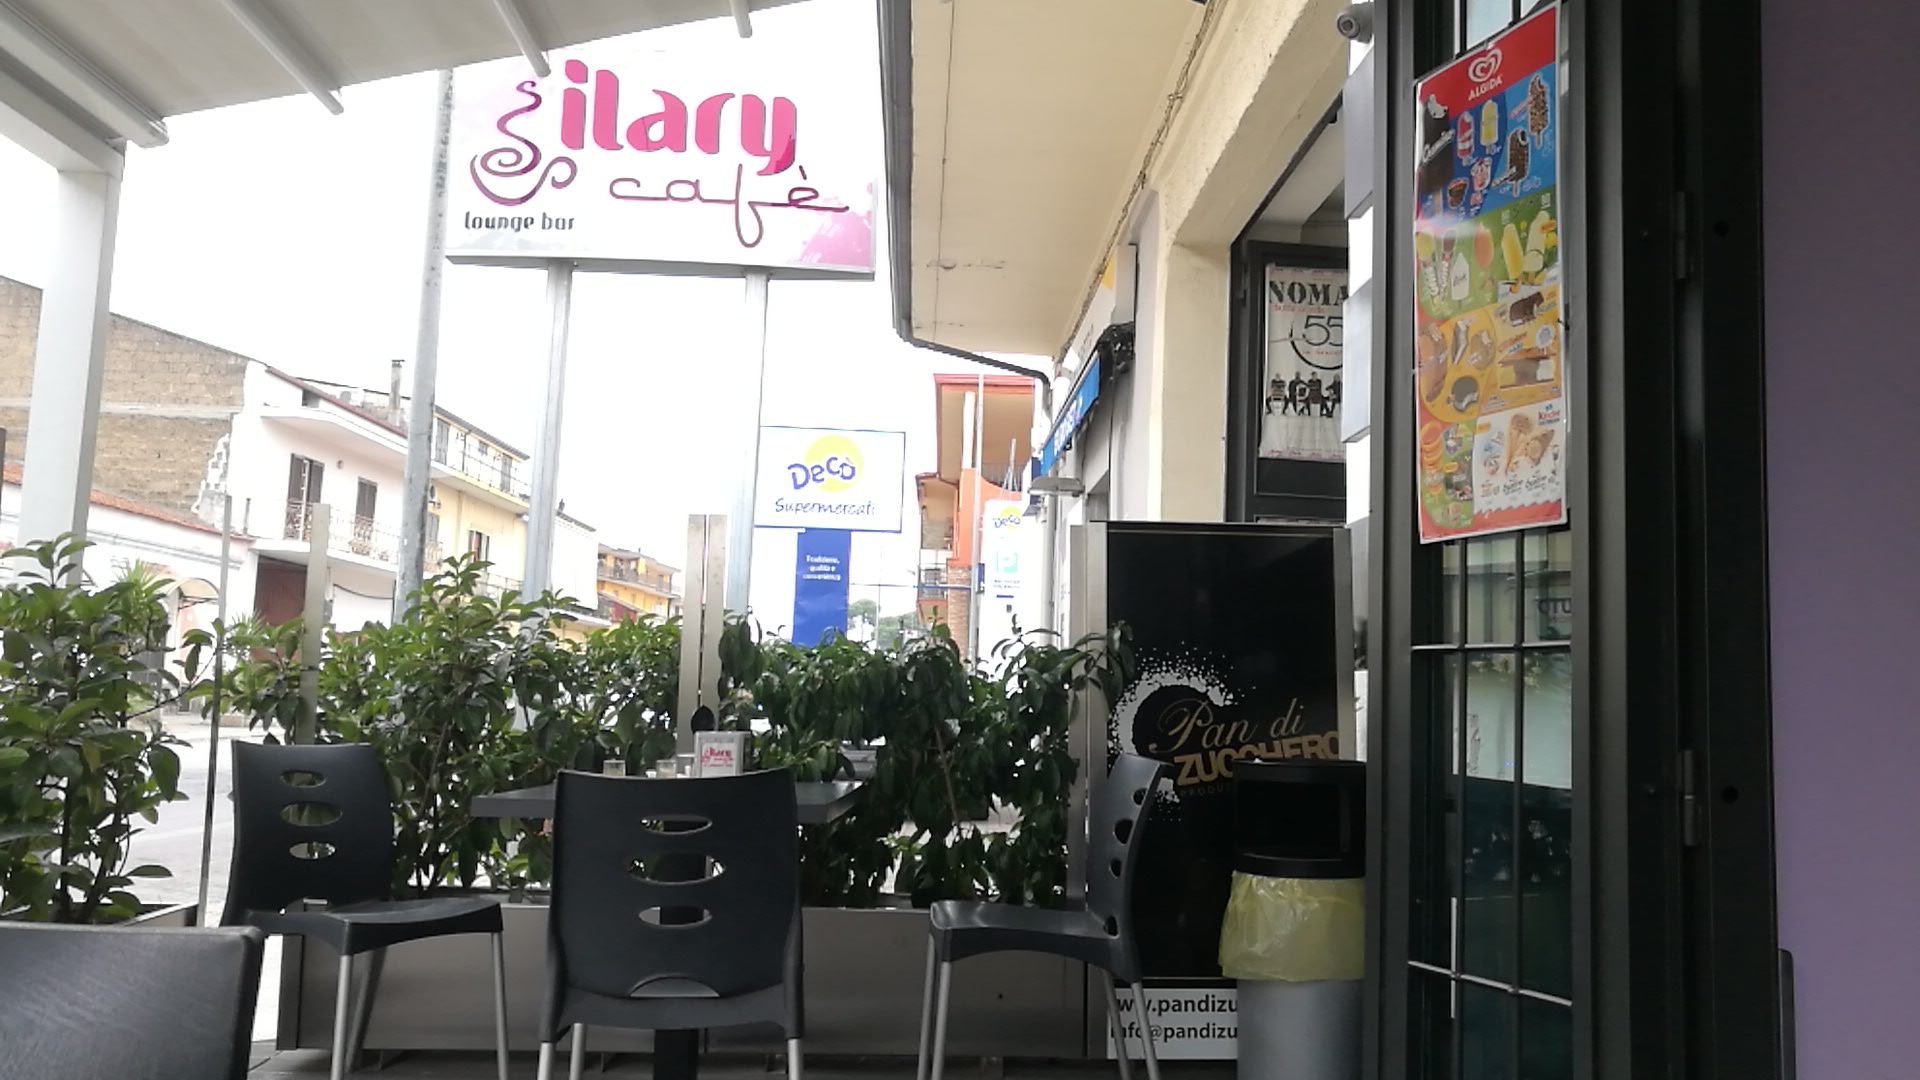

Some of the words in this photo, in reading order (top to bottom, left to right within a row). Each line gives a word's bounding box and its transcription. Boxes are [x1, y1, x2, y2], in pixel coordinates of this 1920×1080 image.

[1468, 74, 1503, 101] ALGIDA
[561, 59, 797, 176] ilary
[464, 211, 535, 232] lounge
[541, 212, 575, 231] bar
[774, 497, 876, 516] Supermercati
[1149, 699, 1259, 754] Pan
[1269, 697, 1306, 738] di
